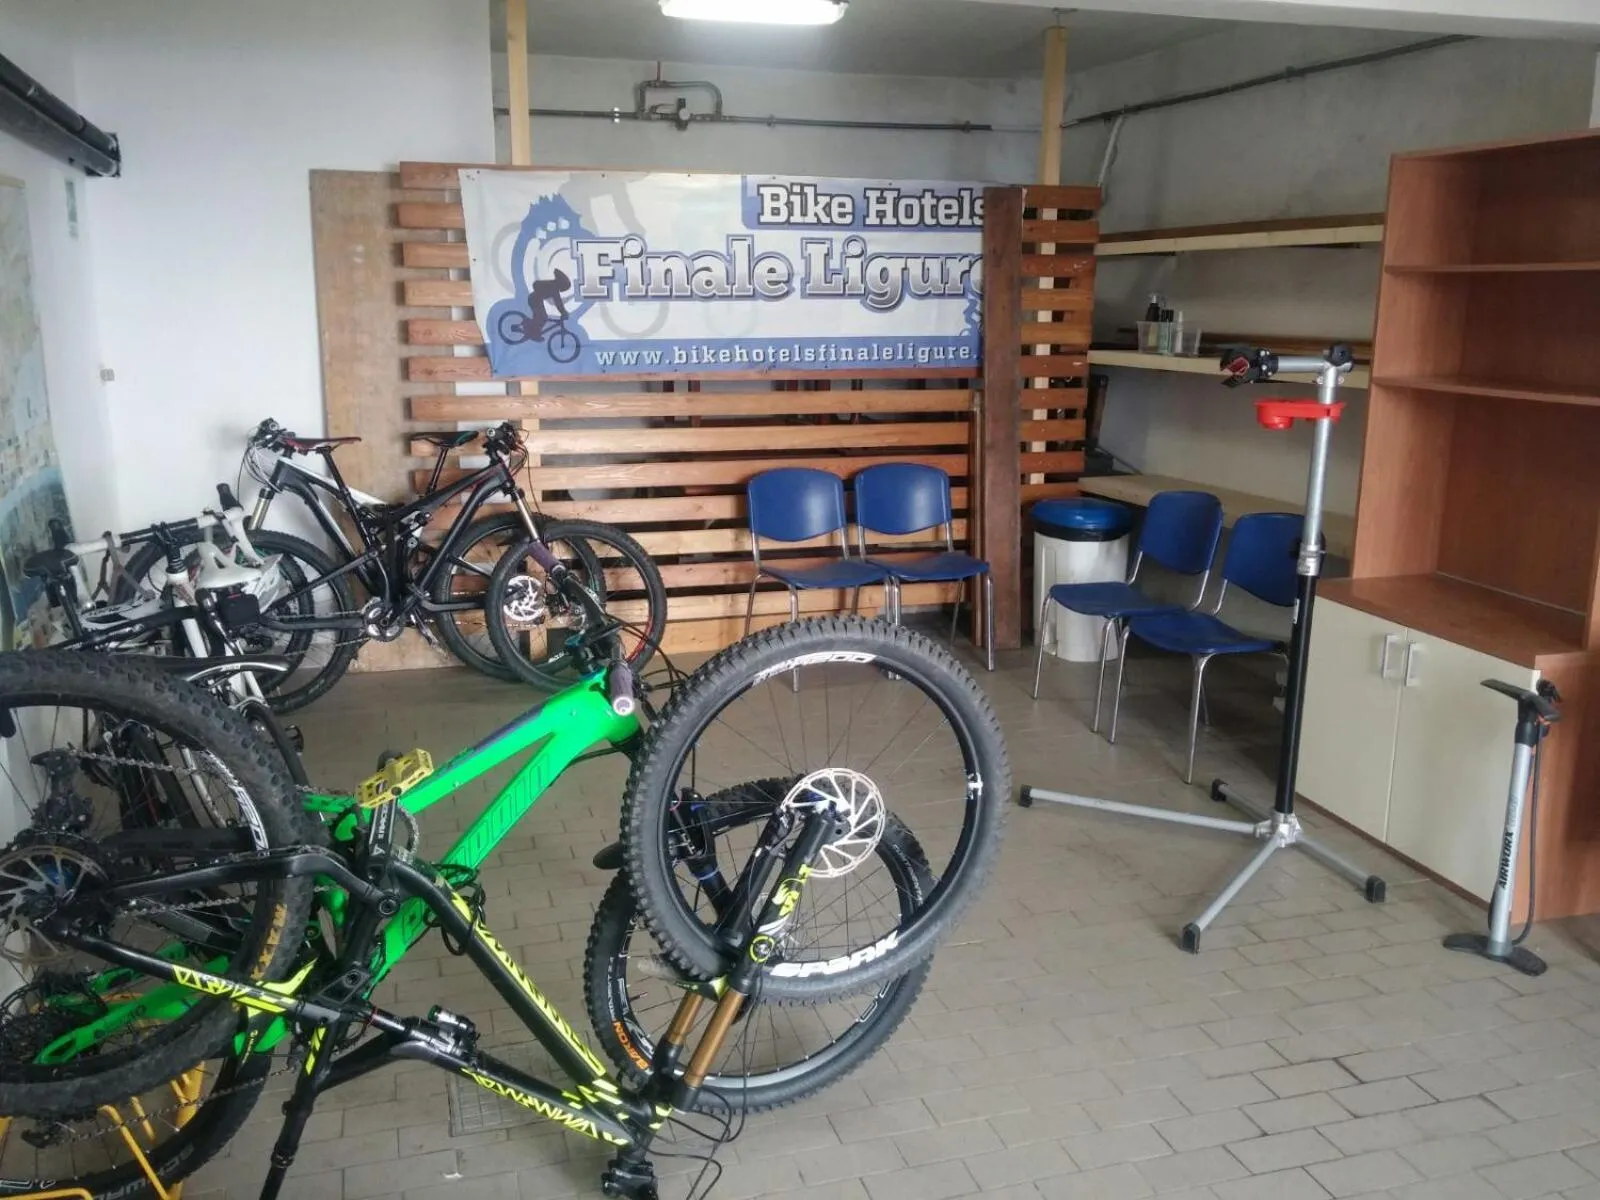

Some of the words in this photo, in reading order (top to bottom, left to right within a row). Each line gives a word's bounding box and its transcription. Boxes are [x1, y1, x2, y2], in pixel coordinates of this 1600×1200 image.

[757, 183, 854, 225] Bike
[573, 234, 793, 300] Finale
[1498, 831, 1514, 889] AIRWORX
